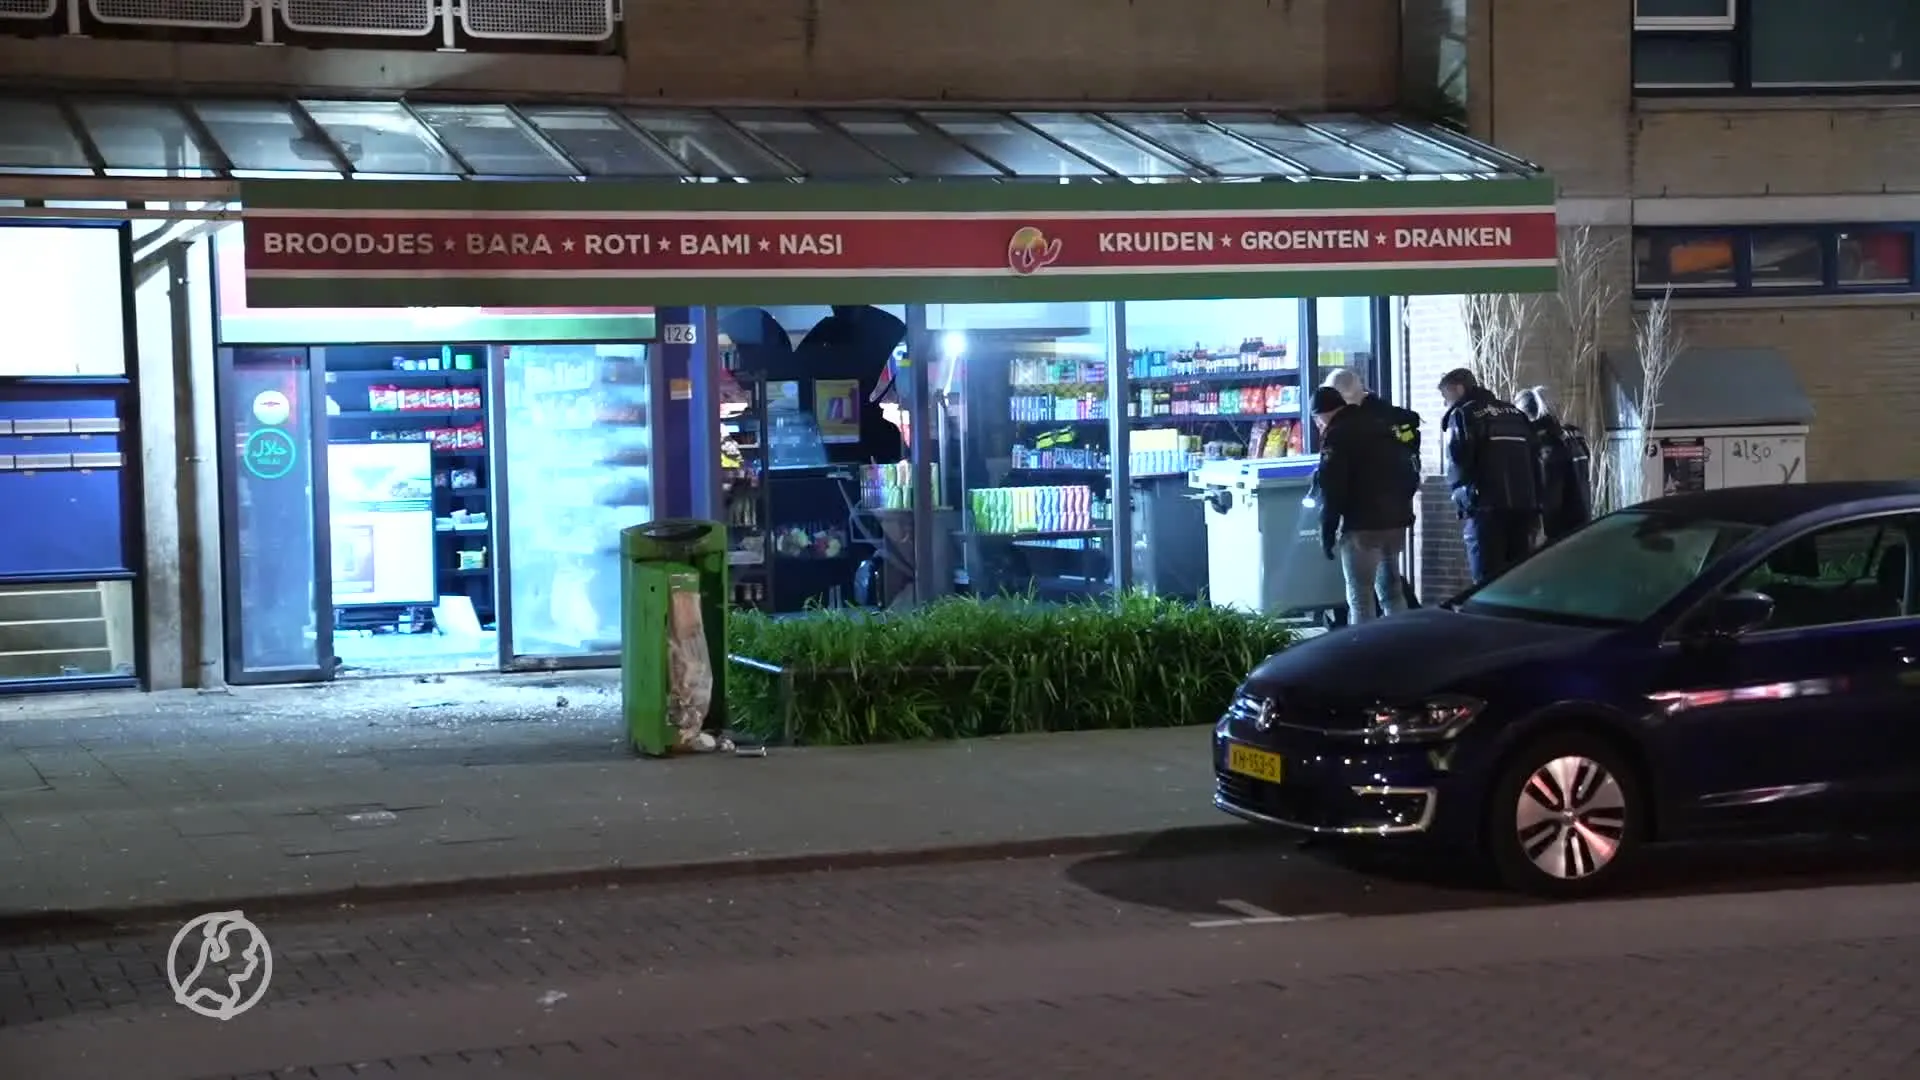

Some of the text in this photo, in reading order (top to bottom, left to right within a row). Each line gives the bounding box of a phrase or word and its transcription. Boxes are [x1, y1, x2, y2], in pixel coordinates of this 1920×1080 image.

[263, 232, 842, 255] BROODJES BARA ROTI BAMI NASI
[1099, 227, 1512, 252] KRUIDEN GROENTEN DRANKEN
[667, 327, 694, 341] 126
